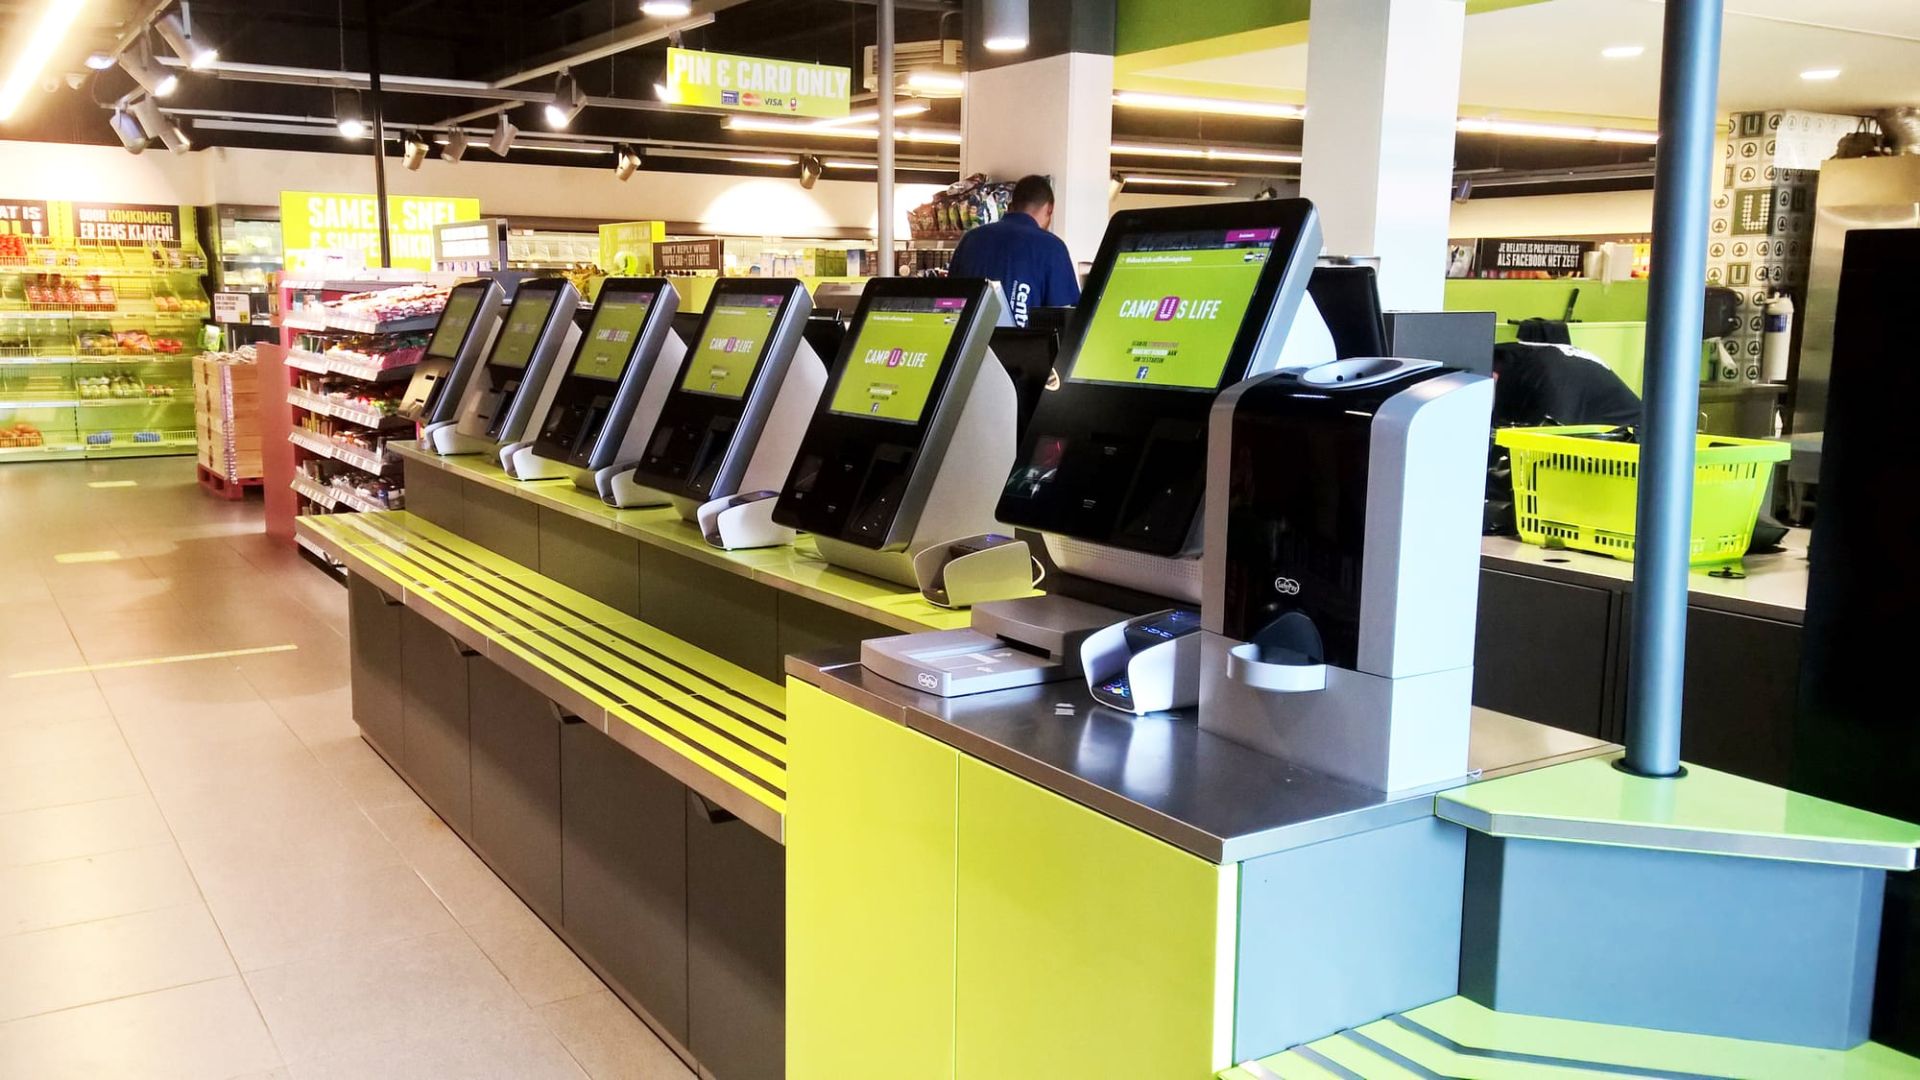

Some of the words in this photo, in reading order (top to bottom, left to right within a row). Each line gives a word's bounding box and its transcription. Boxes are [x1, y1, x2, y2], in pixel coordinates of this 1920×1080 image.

[672, 54, 712, 85] PIN
[737, 60, 792, 95] CARD
[796, 66, 849, 99] ONLY
[764, 97, 783, 107] VISA
[23, 206, 41, 220] IS
[107, 209, 173, 225] KOMKOMMER
[1742, 193, 1771, 231] U
[79, 222, 95, 239] ER
[96, 222, 126, 240] EENS
[128, 223, 174, 241] KIJKEN!
[1498, 242, 1506, 253] JE
[1506, 243, 1527, 253] RELATIE
[1527, 243, 1533, 253] IS
[1534, 243, 1544, 254] PAS
[1544, 244, 1569, 254] OFFICIEEL
[1570, 244, 1580, 255] ALS
[1497, 253, 1511, 266] ALS
[1512, 253, 1547, 267] FACEBOOK
[1547, 254, 1561, 267] HET
[1562, 255, 1579, 268] ZEGT
[1119, 296, 1189, 322] CAMPUS
[1188, 299, 1223, 320] LIFE
[738, 340, 755, 354] LIFE
[864, 348, 909, 368] CAMPUS
[906, 353, 928, 368] LIFE
